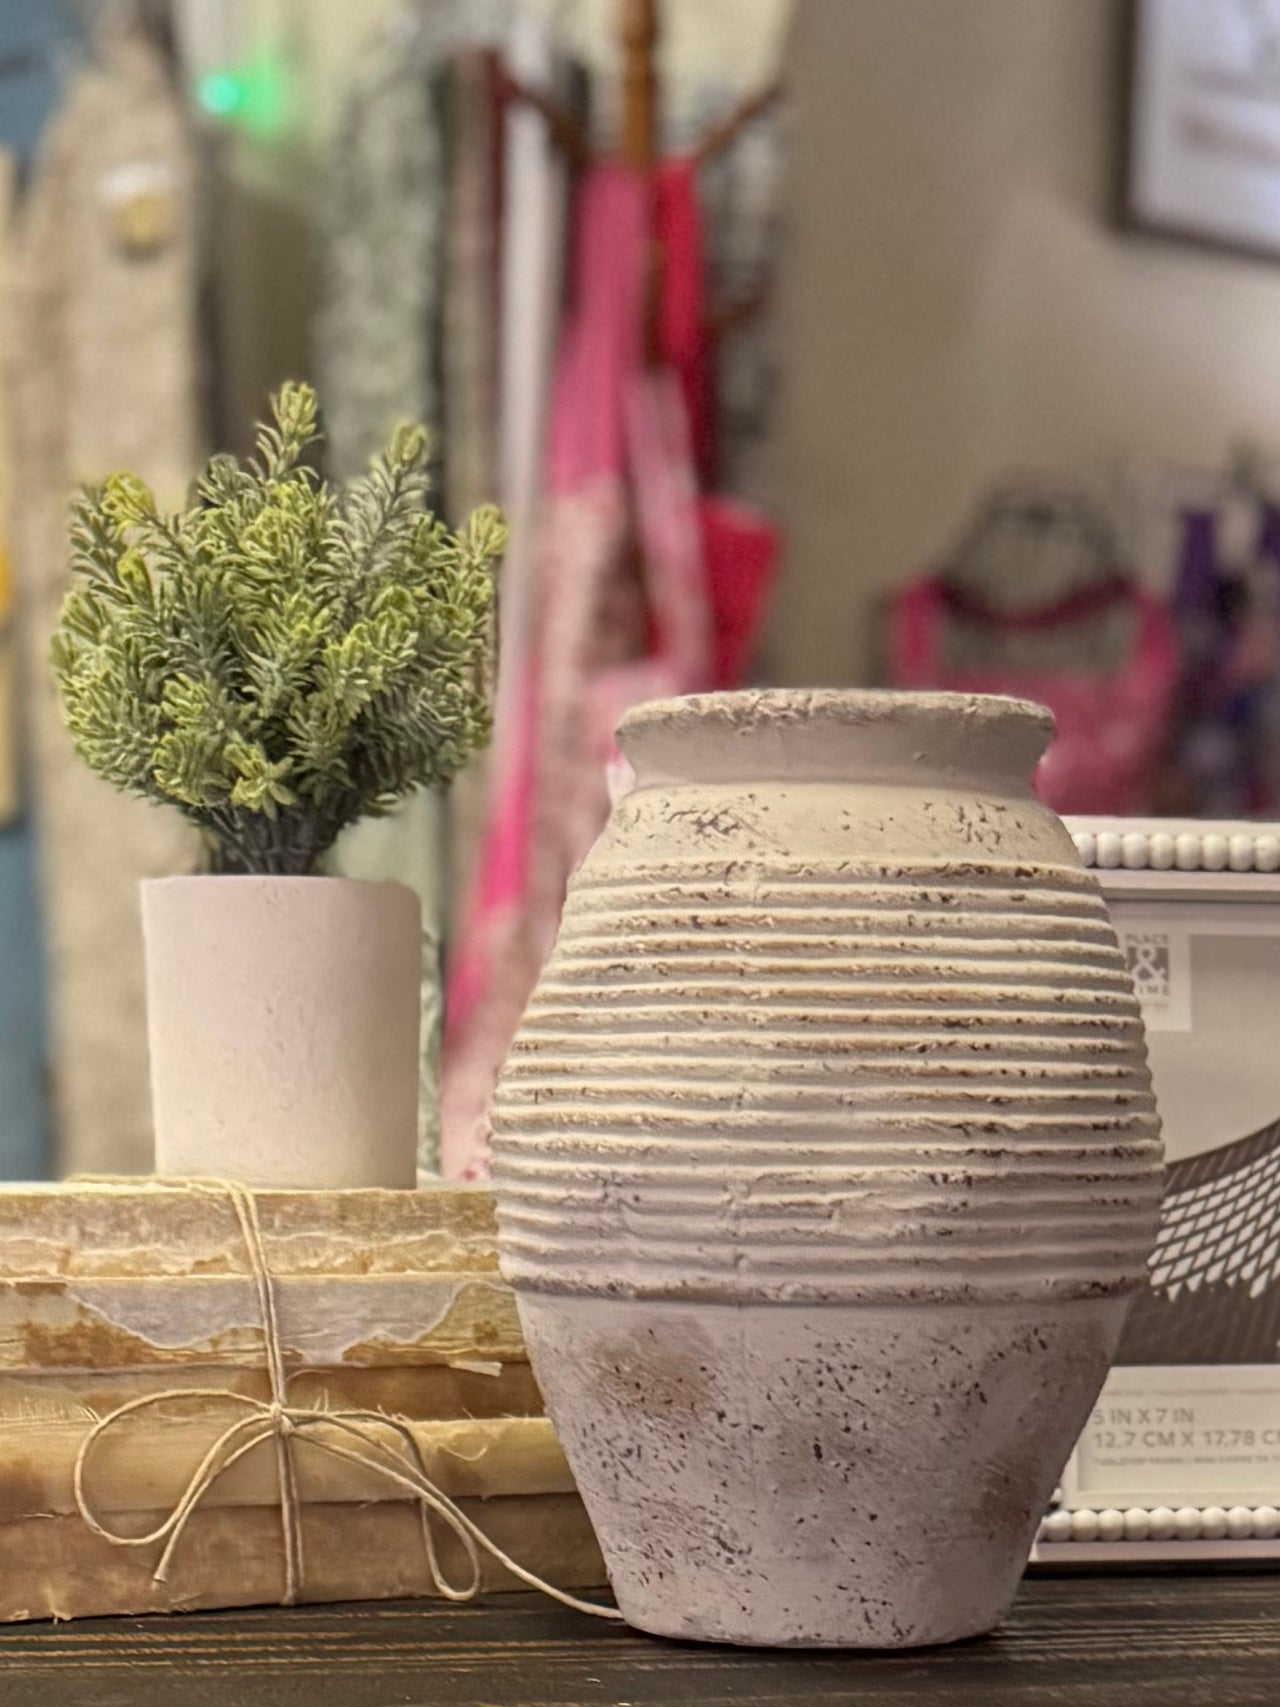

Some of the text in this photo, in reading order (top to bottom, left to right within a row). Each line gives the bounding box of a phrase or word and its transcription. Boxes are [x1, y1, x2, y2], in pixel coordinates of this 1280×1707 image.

[1125, 933, 1168, 944] PLACE
[1129, 946, 1168, 982] &
[1093, 1408, 1194, 1424] 5 IN X 7 IN
[1143, 1430, 1175, 1447] CM
[1182, 1430, 1195, 1446] X
